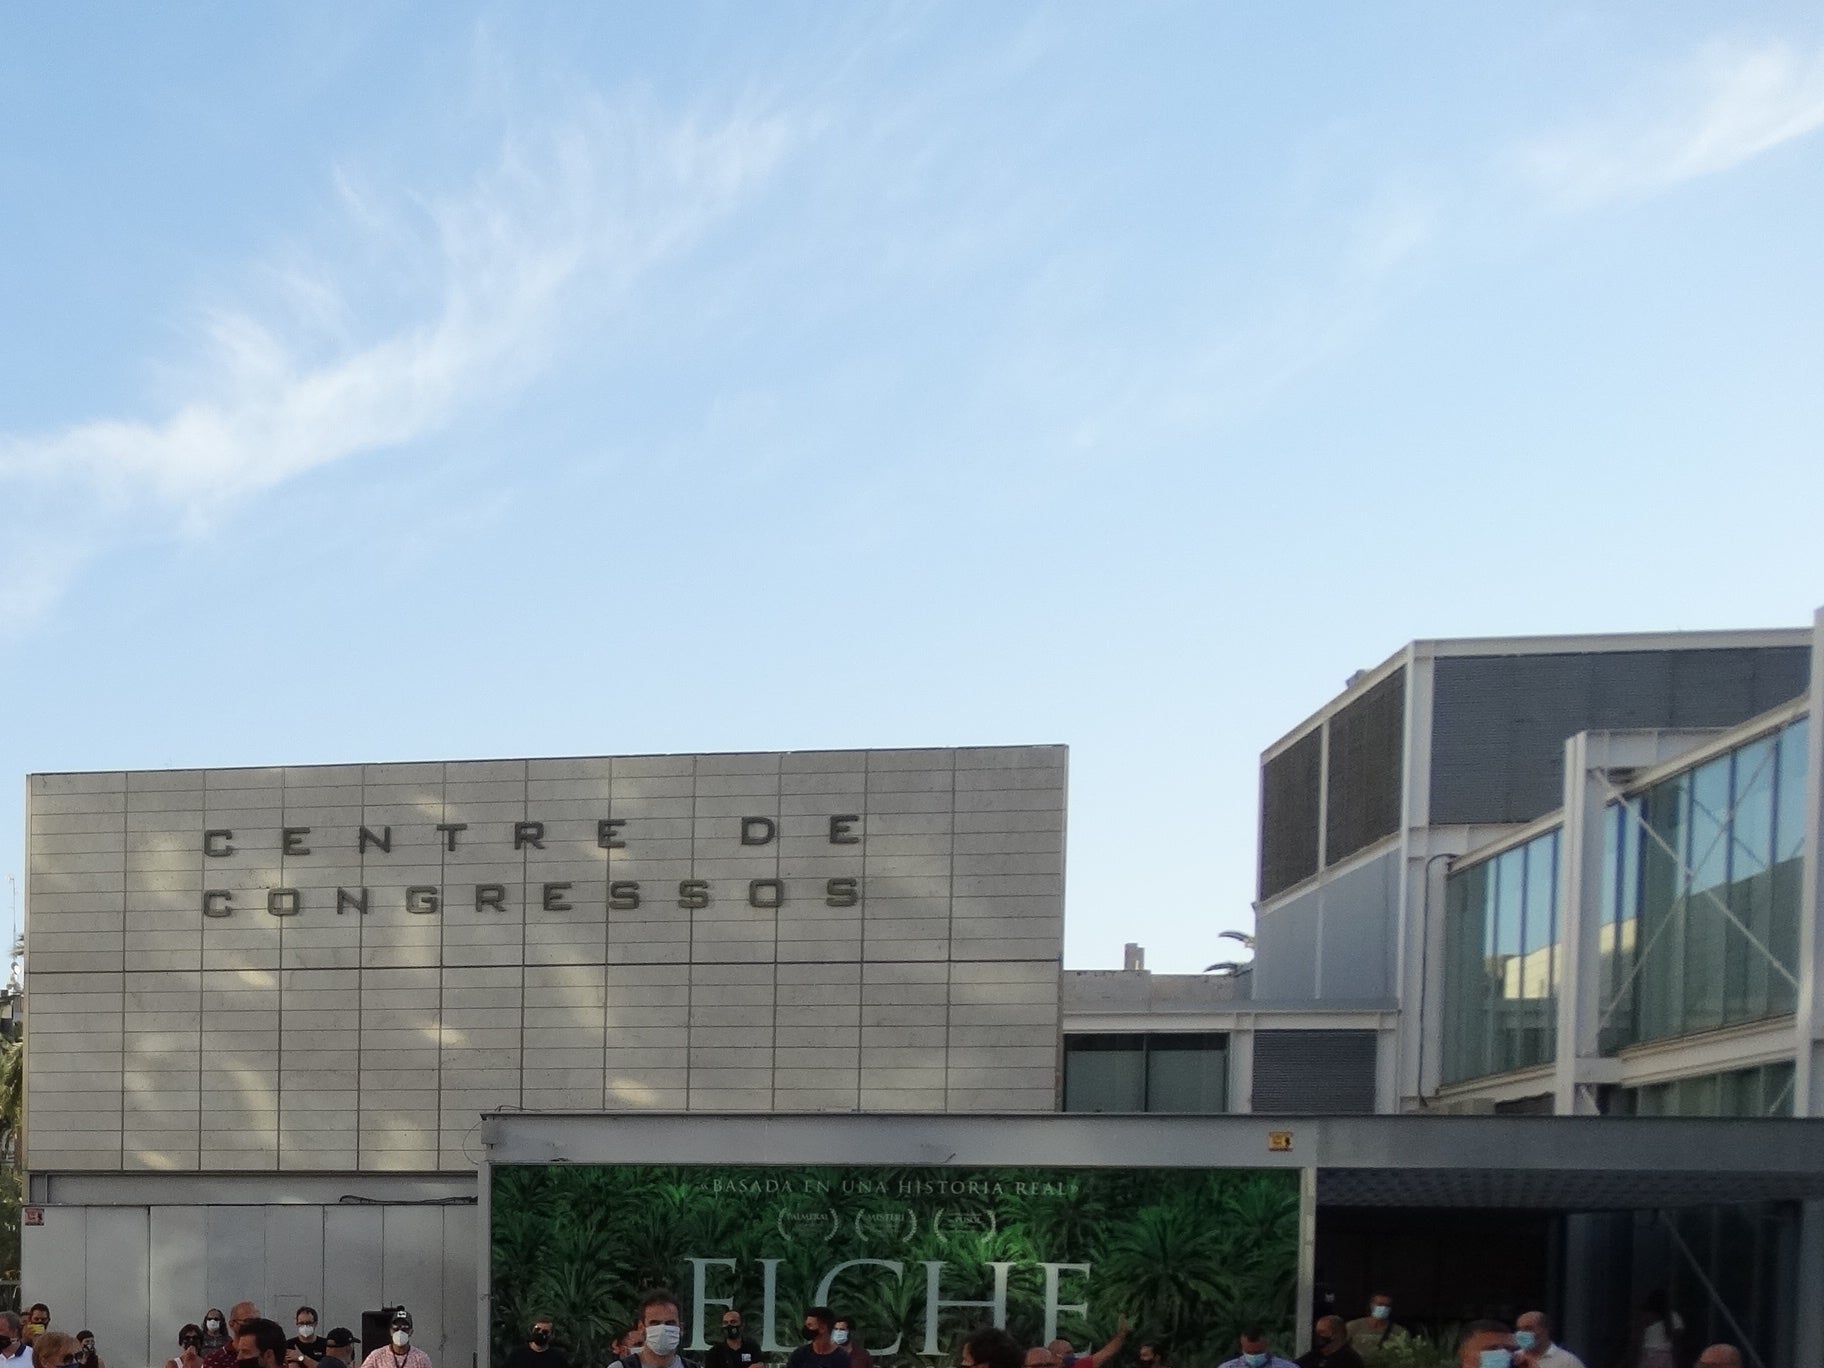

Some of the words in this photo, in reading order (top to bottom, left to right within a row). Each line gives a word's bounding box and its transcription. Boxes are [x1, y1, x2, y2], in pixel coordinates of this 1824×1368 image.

[203, 818, 628, 857] CENTRE
[740, 815, 861, 845] DE
[202, 878, 861, 918] CONGRESSOS
[805, 1179, 830, 1193] EN
[842, 1179, 887, 1194] UNA
[898, 1179, 1004, 1196] HISTORIA
